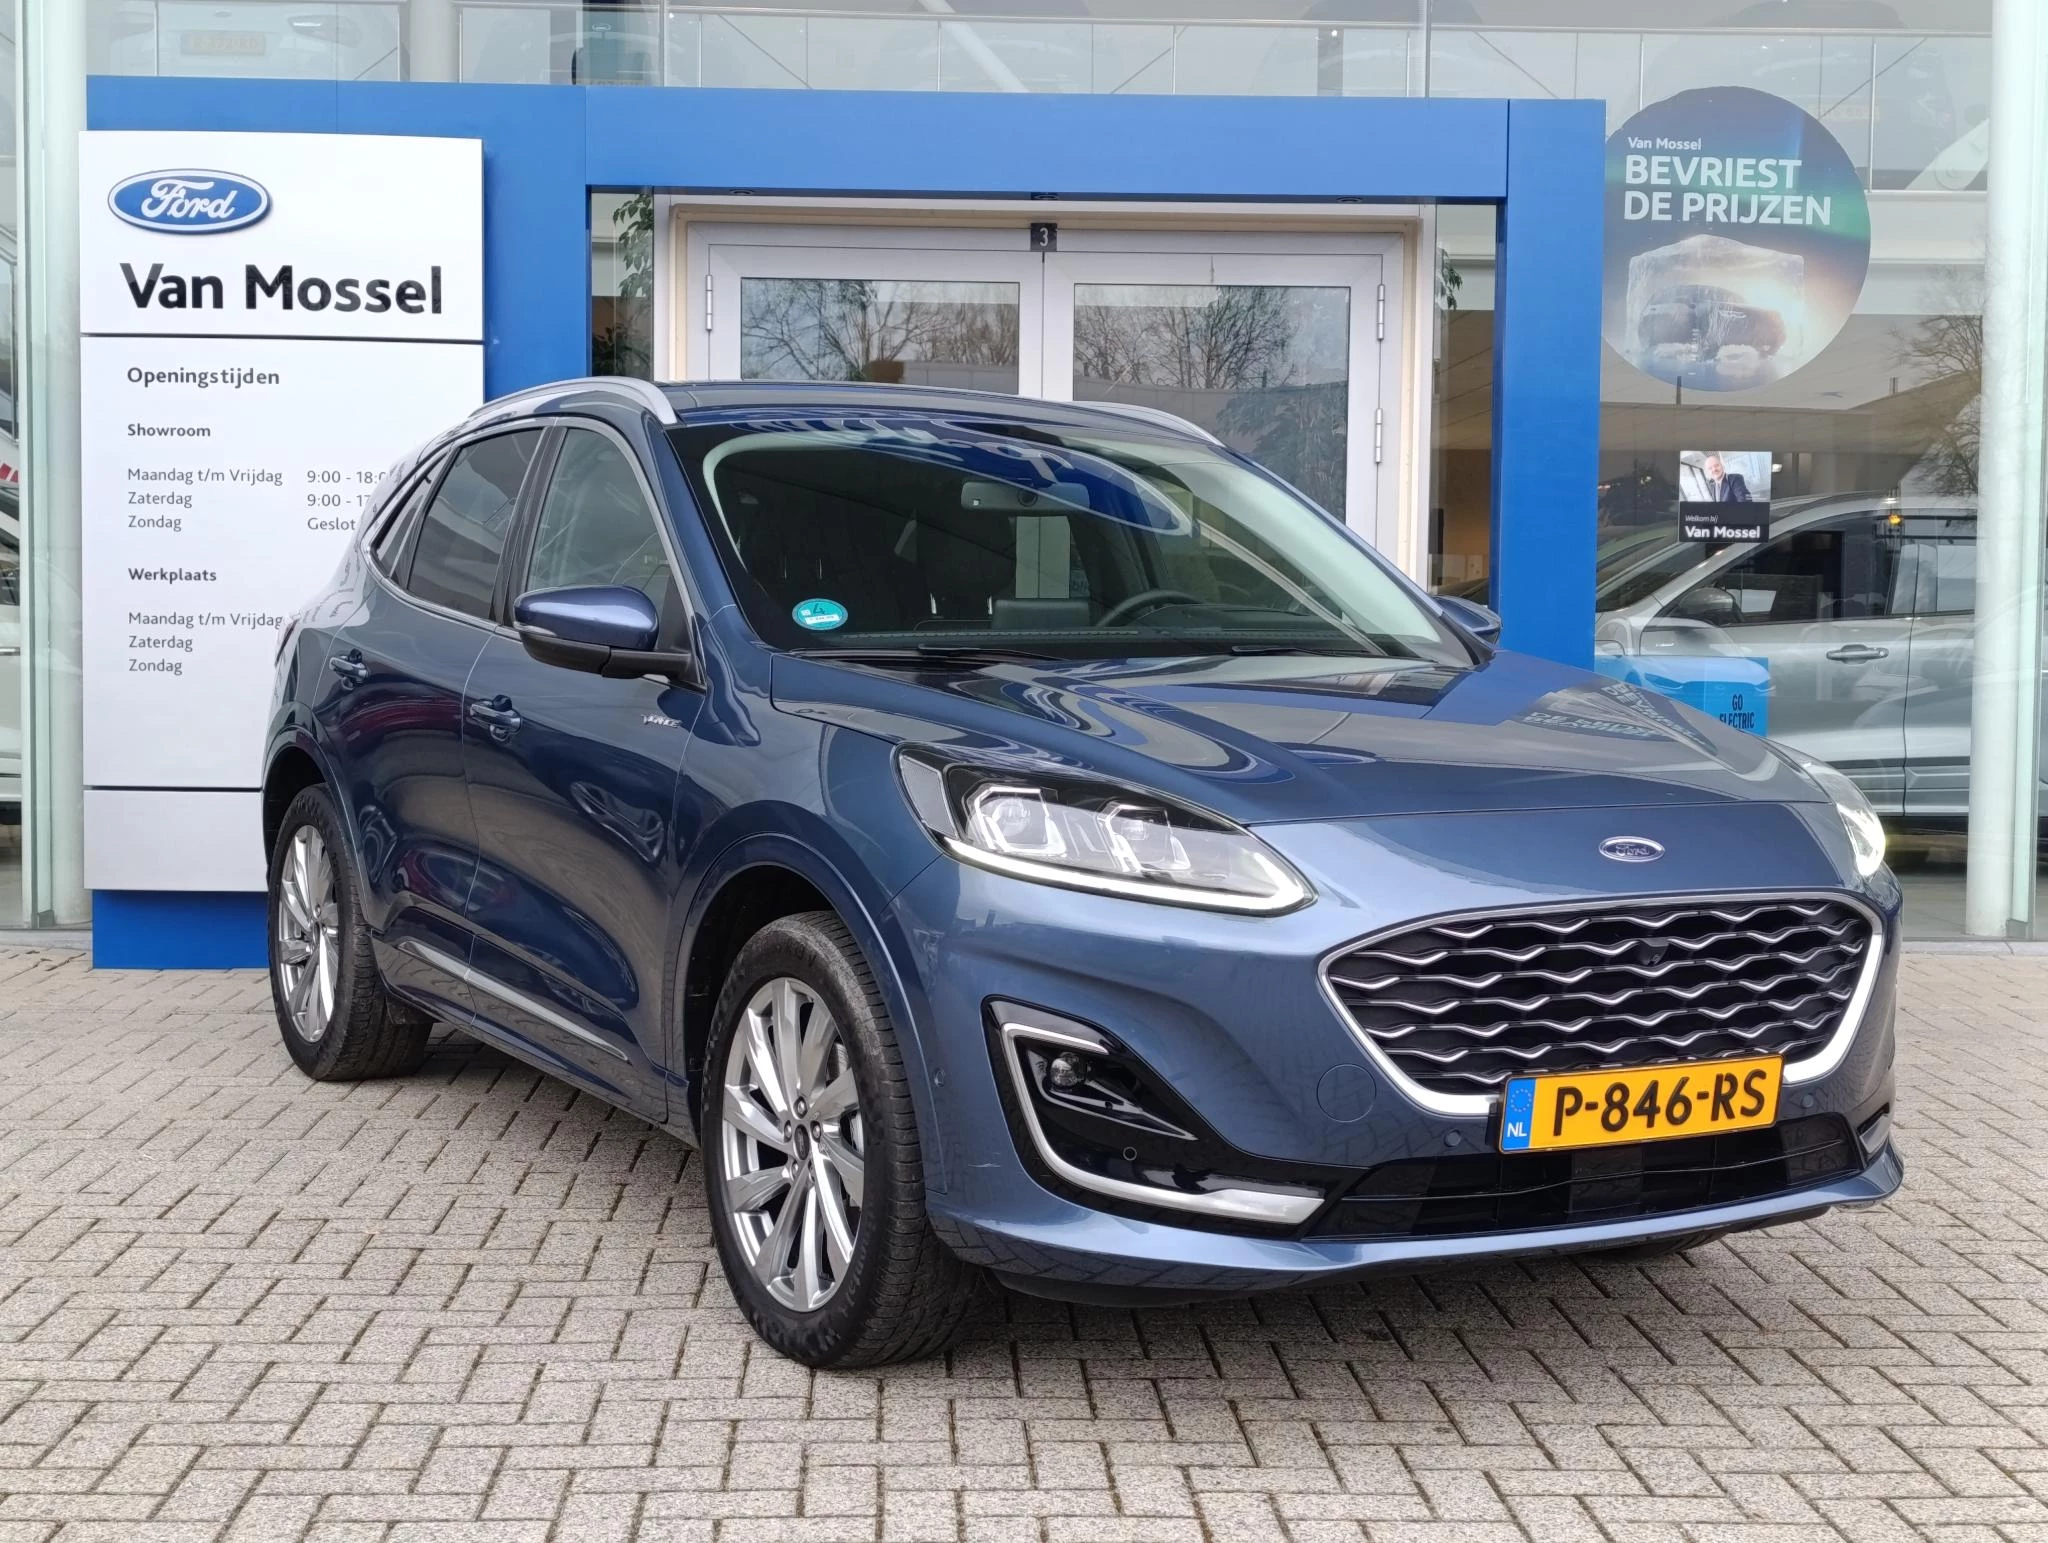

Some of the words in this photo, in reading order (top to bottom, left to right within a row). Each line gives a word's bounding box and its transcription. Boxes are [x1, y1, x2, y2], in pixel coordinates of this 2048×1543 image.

[1628, 137, 1652, 149] Van
[1656, 137, 1702, 150] Mossel
[1625, 154, 1802, 189] BEVRIEST
[141, 178, 238, 219] Ford
[1623, 190, 1672, 221] DE
[1682, 192, 1831, 226] PRIJZEN
[1039, 226, 1049, 247] 3
[119, 262, 223, 309] Van
[245, 264, 442, 314] Mossel
[127, 367, 280, 389] Openingstijden
[127, 423, 211, 437] Showroom
[128, 468, 194, 485] Maandag
[198, 468, 225, 483] t/m
[229, 469, 283, 487] Vrijdag
[307, 470, 341, 483] 9:00
[128, 491, 193, 508] Zaterdag
[307, 494, 341, 507] 9:00
[128, 515, 182, 532] Zondag
[1684, 525, 1711, 538] Van
[1713, 525, 1760, 538] Mossel
[128, 568, 217, 584] Werkplaats
[128, 612, 194, 629] Maandag
[198, 612, 225, 626] t/m
[230, 613, 283, 630] Vrijdag
[128, 635, 193, 652] Zaterdag
[128, 659, 183, 676] Zondag
[1732, 693, 1744, 711] GO
[1553, 1069, 1767, 1136] P-846-RS
[1507, 1122, 1527, 1137] NL
